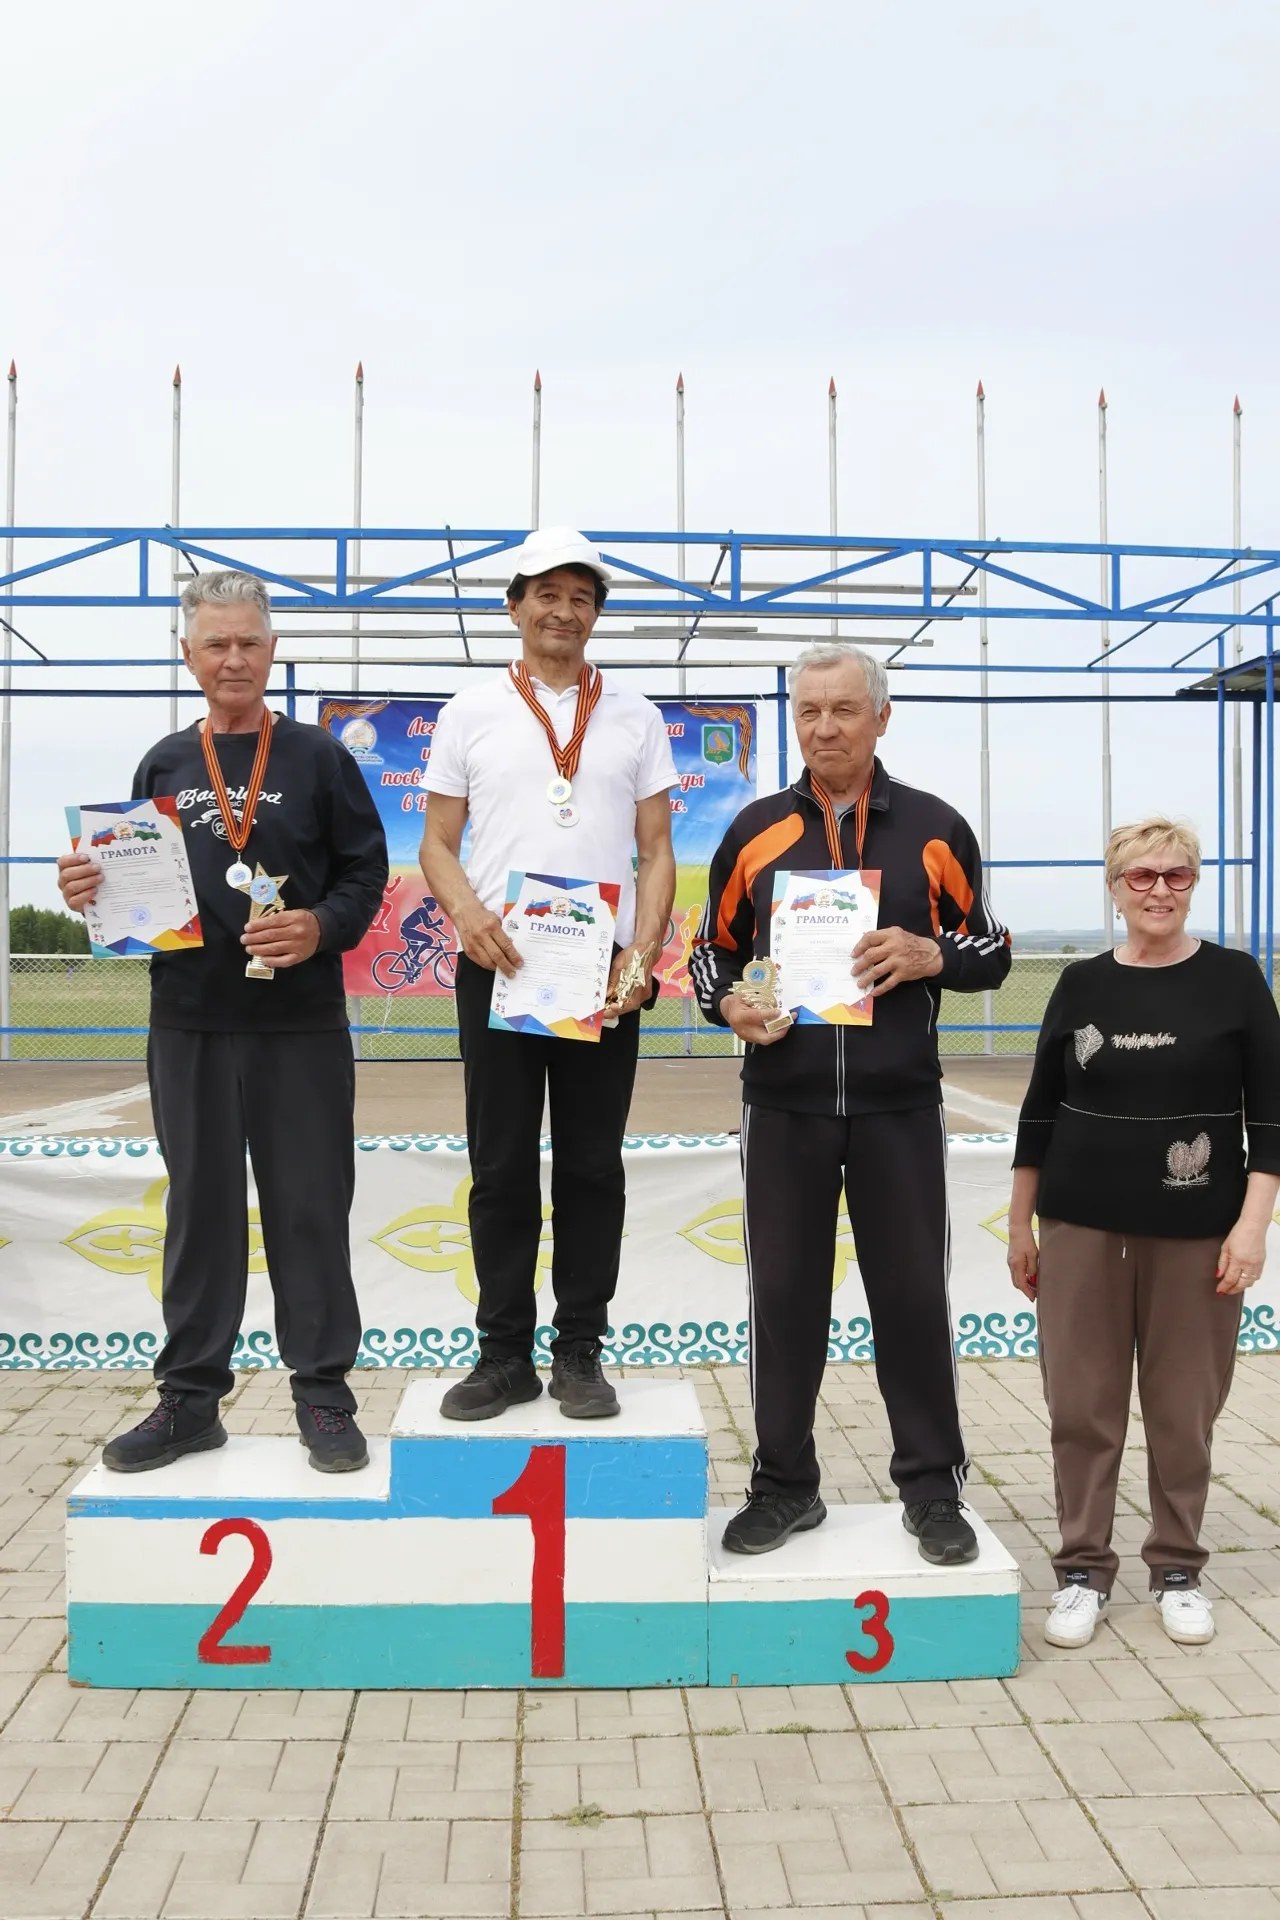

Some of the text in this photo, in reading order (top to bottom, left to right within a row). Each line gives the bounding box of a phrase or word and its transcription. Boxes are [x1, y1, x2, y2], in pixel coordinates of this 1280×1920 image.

[381, 768, 425, 786] посв
[206, 800, 242, 808] CLSIC
[100, 846, 157, 860] ГРАМОТА
[796, 915, 849, 924] ГРАМОТА
[530, 922, 586, 937] ГРАМОТА
[492, 1445, 566, 1678] 1
[197, 1517, 272, 1665] 2
[845, 1589, 895, 1674] 3
